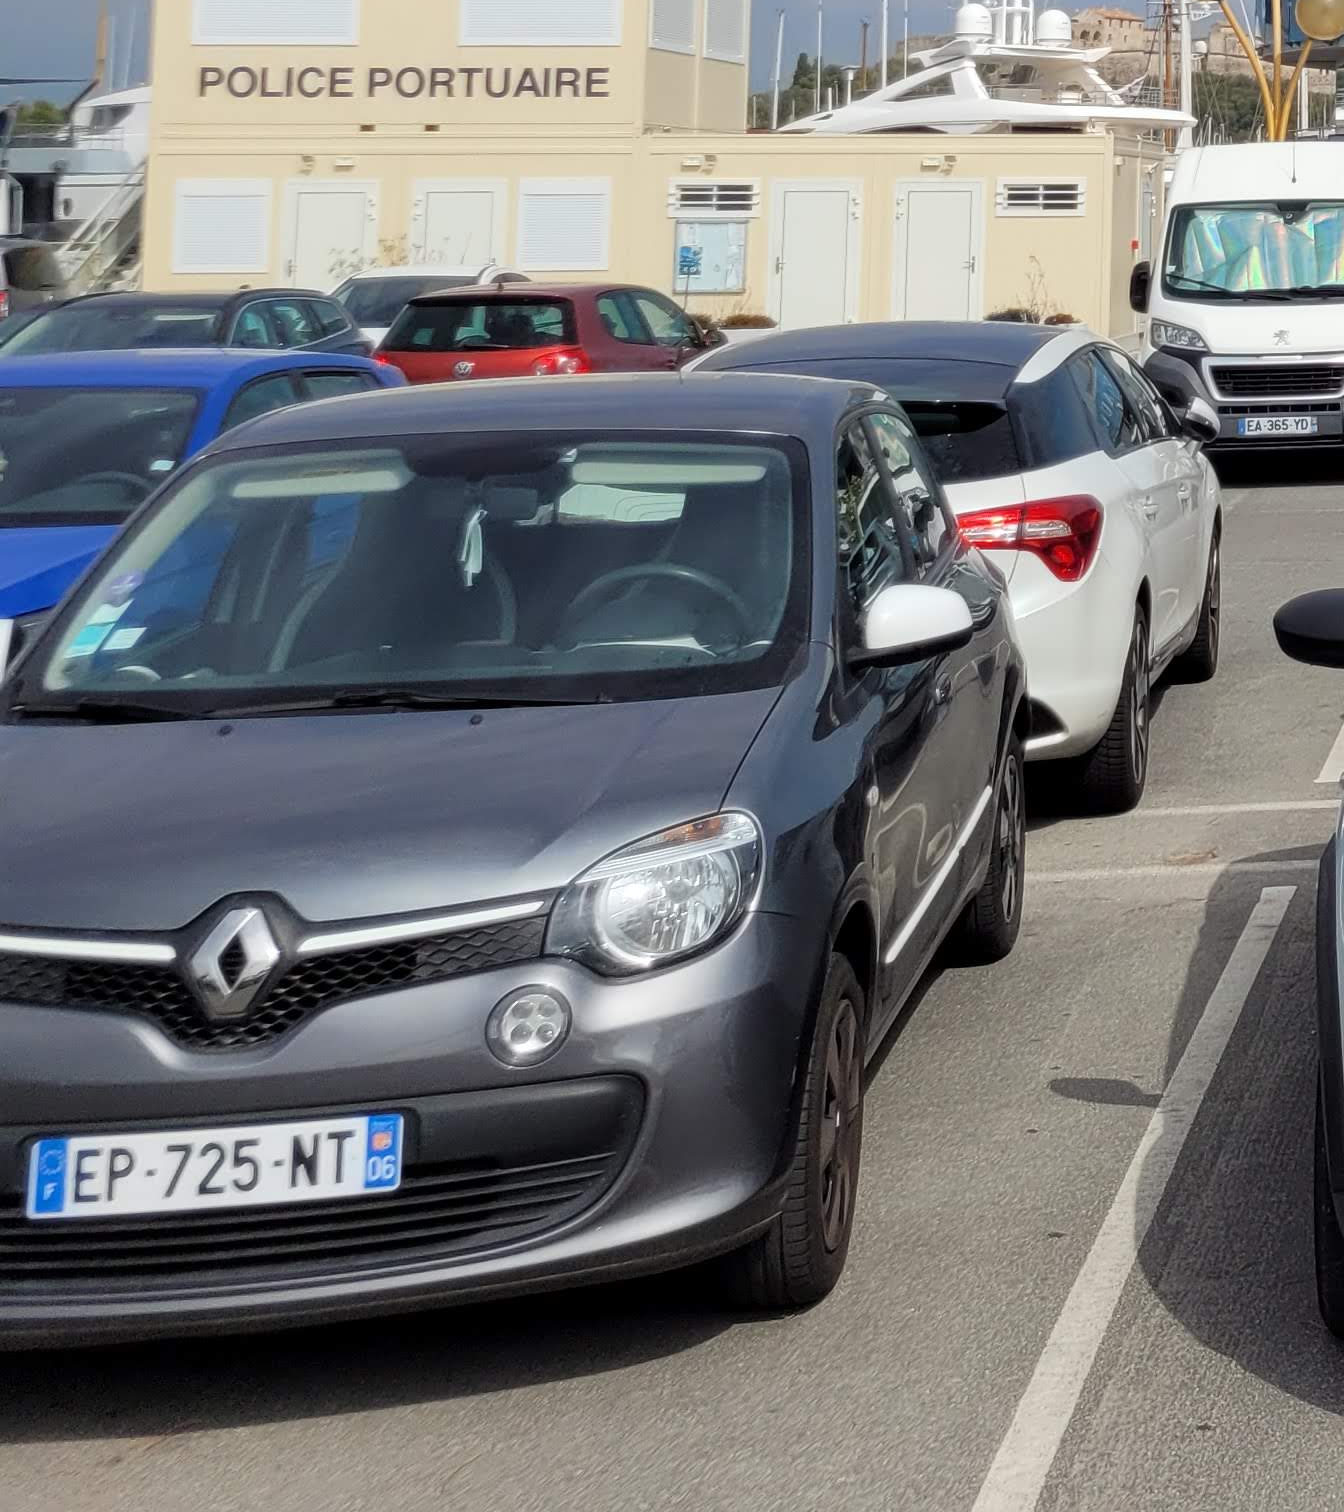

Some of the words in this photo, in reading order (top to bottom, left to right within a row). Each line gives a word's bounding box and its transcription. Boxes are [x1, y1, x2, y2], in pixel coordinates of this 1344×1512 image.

[199, 66, 355, 99] POLICE
[367, 66, 611, 99] PORTUAIRE
[1246, 418, 1309, 432] EA-365-YD
[43, 1184, 59, 1201] F
[73, 1128, 356, 1204] EP-725-NT
[367, 1155, 396, 1181] 06
